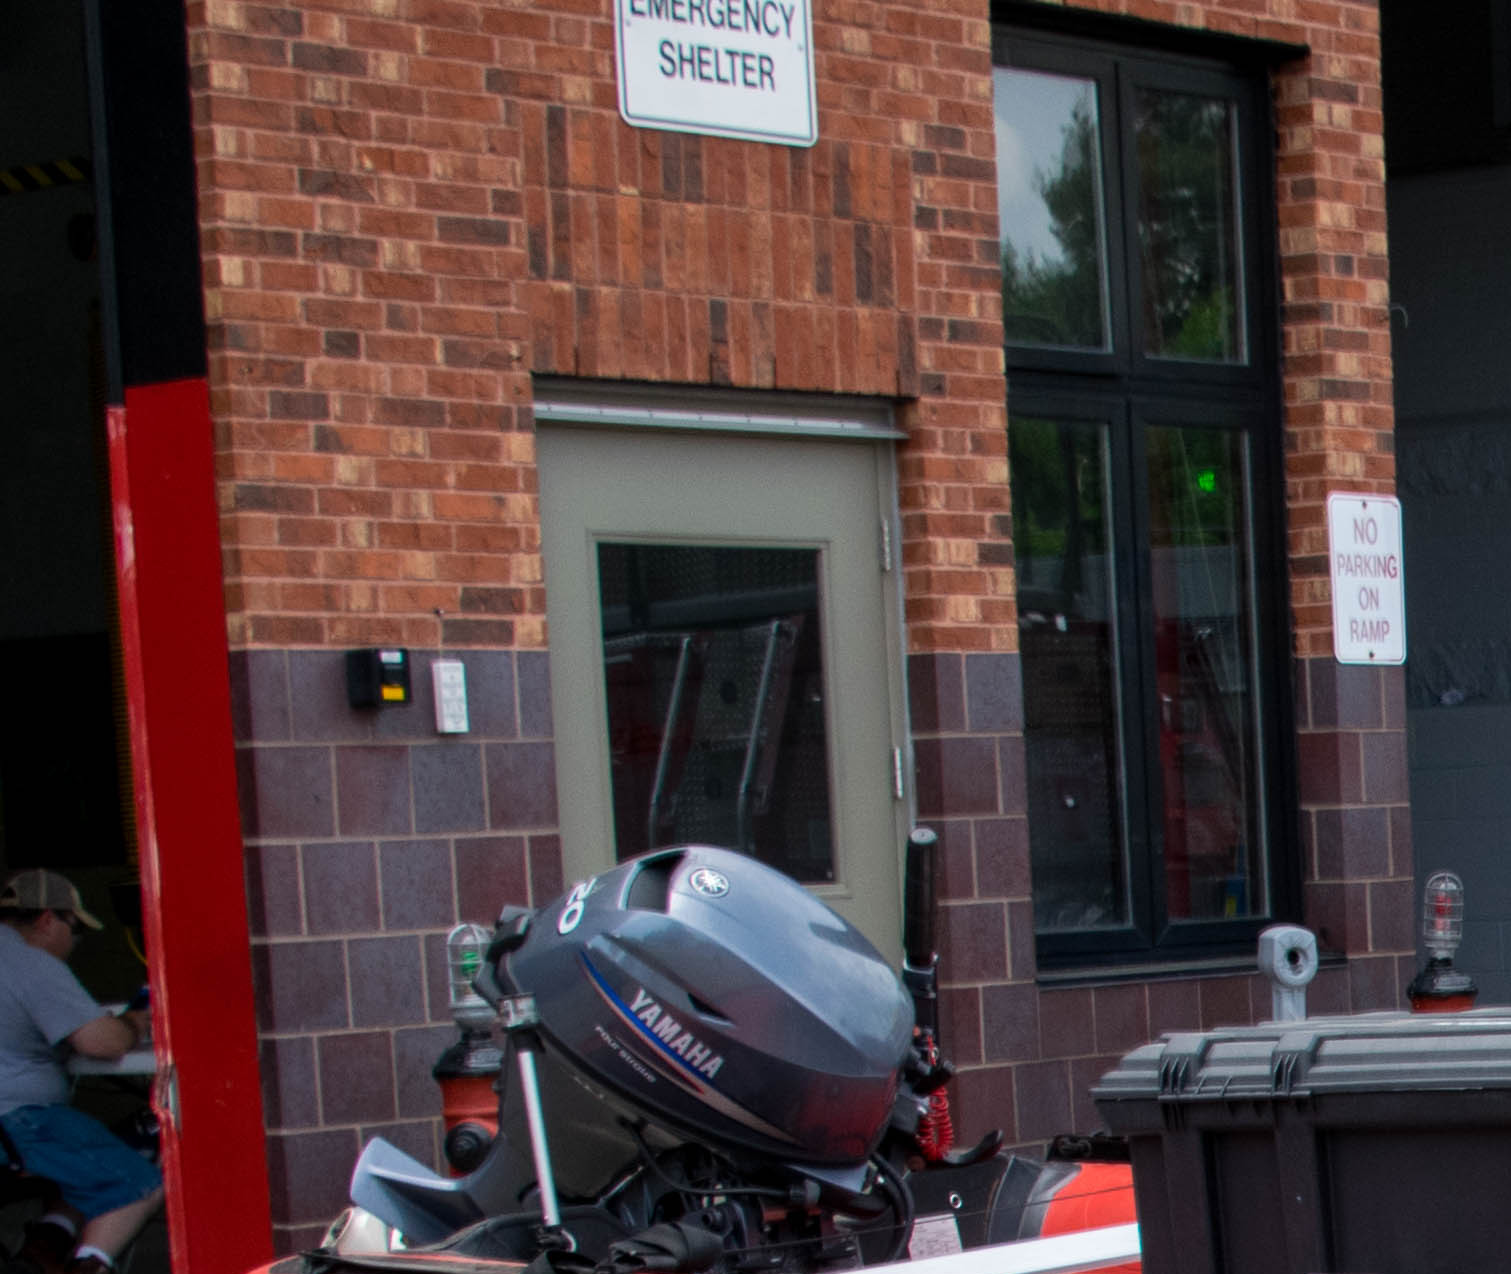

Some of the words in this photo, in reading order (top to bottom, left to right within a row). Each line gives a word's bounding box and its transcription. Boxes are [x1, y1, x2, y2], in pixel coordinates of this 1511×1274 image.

[658, 39, 776, 91] SHELTER
[1352, 517, 1378, 545] NO
[1336, 553, 1398, 579] PARKING
[1357, 586, 1380, 611] ON
[1350, 619, 1391, 643] RAMP
[629, 989, 725, 1079] YAMAHA
